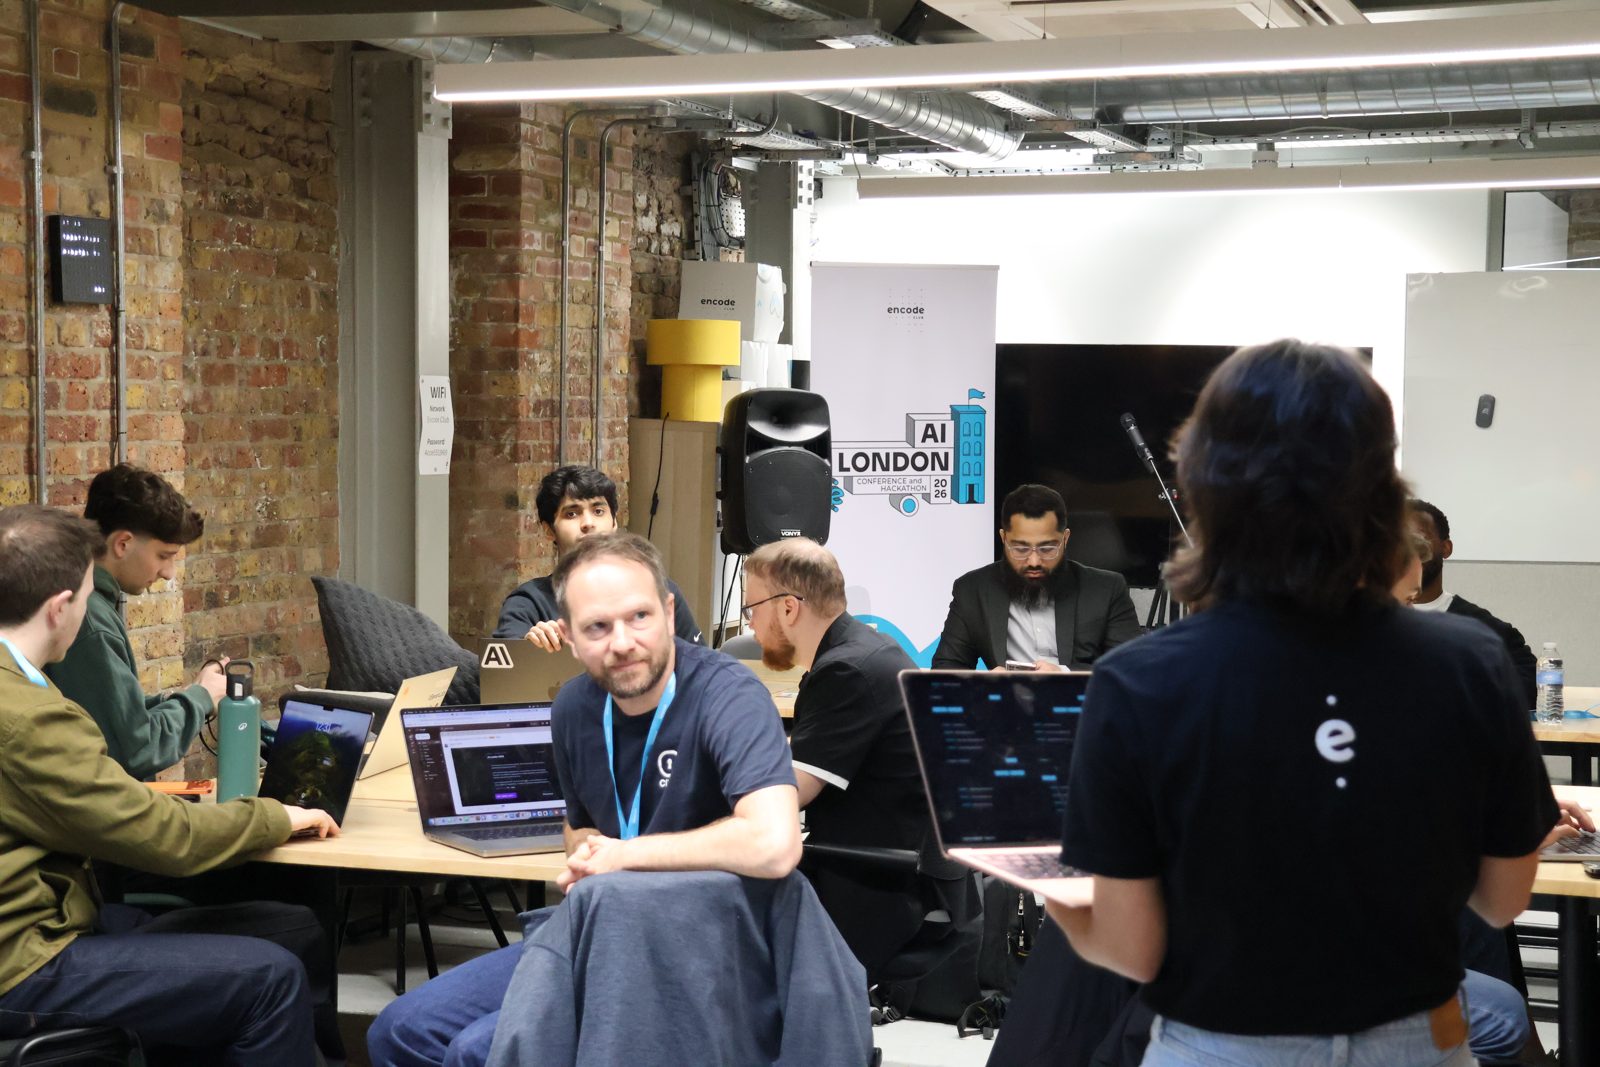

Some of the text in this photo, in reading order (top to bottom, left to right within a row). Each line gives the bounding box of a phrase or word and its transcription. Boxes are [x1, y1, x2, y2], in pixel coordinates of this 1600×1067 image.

[701, 298, 736, 306] encode
[887, 306, 925, 315] encode
[921, 423, 946, 443] AI
[838, 451, 949, 473] LONDON
[934, 479, 947, 487] 20
[934, 490, 947, 498] 26
[1314, 719, 1356, 762] e
